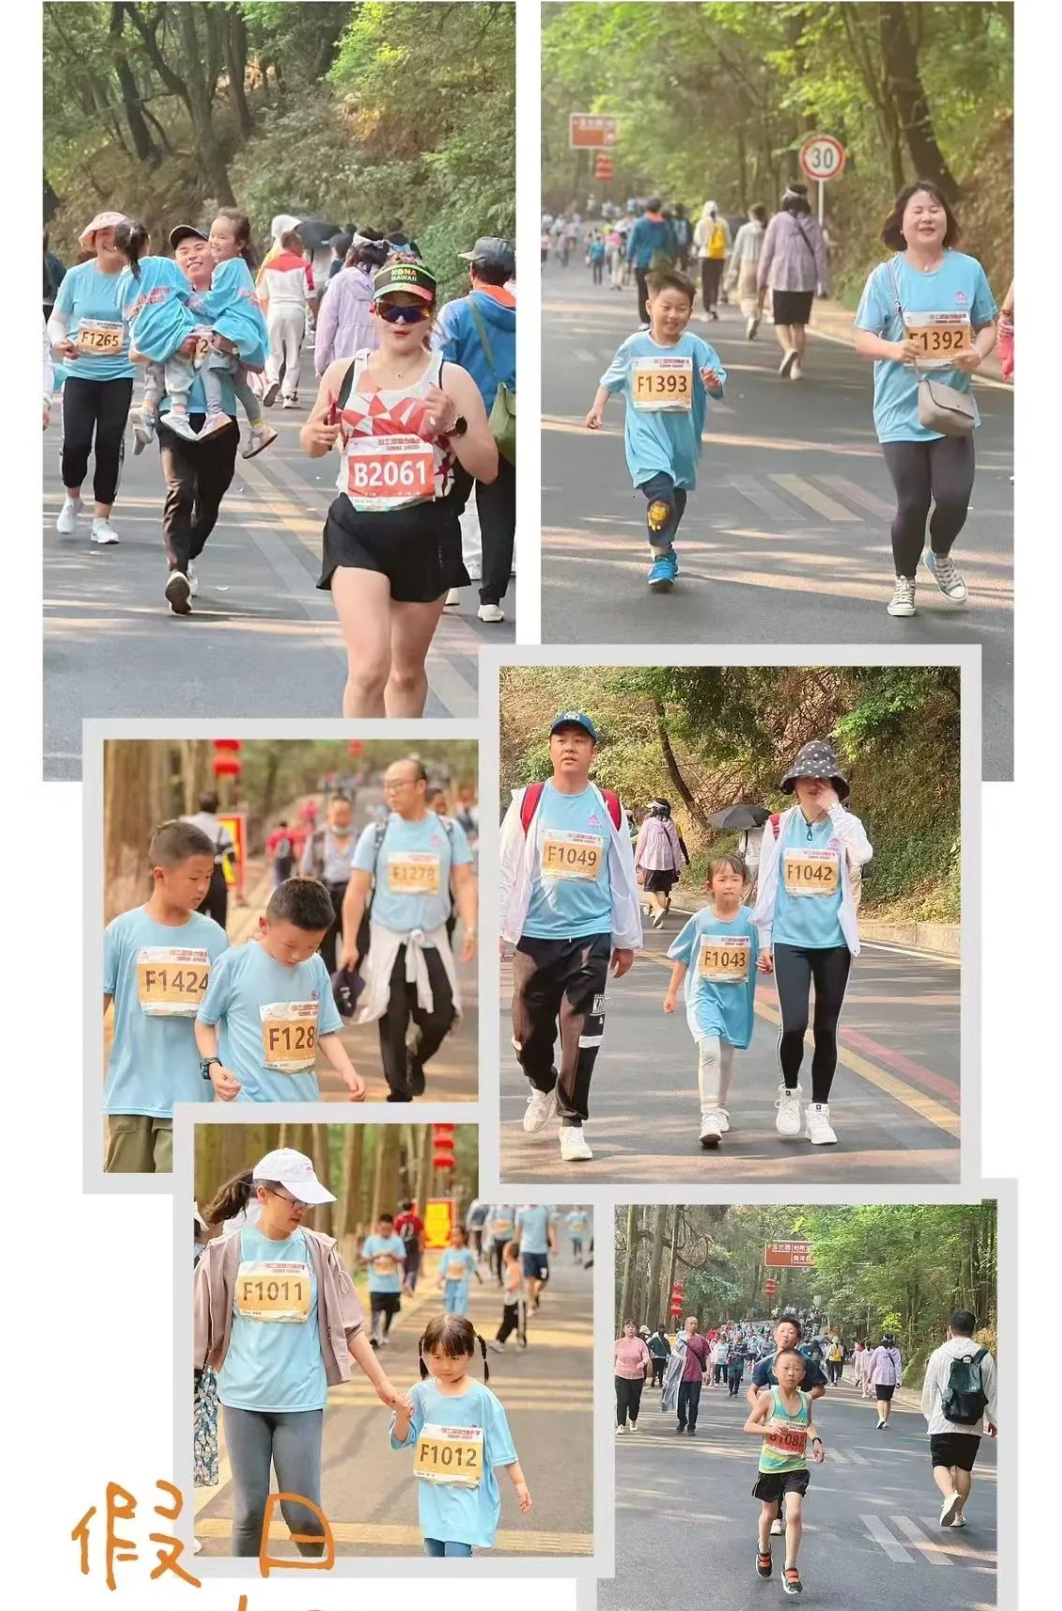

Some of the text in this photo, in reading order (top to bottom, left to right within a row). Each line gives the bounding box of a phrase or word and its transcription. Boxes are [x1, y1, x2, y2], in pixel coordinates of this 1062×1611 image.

[811, 147, 833, 169] 30
[391, 267, 418, 276] KONA
[80, 330, 119, 348] F1265
[909, 330, 965, 352] F1392
[637, 375, 688, 394] F1393
[354, 459, 428, 488] B2061
[547, 844, 598, 868] F1049
[786, 864, 833, 882] F1042
[703, 951, 746, 969] F1043
[145, 969, 209, 993] F1424
[242, 1279, 303, 1302] F1011
[419, 1443, 477, 1467] F1012
